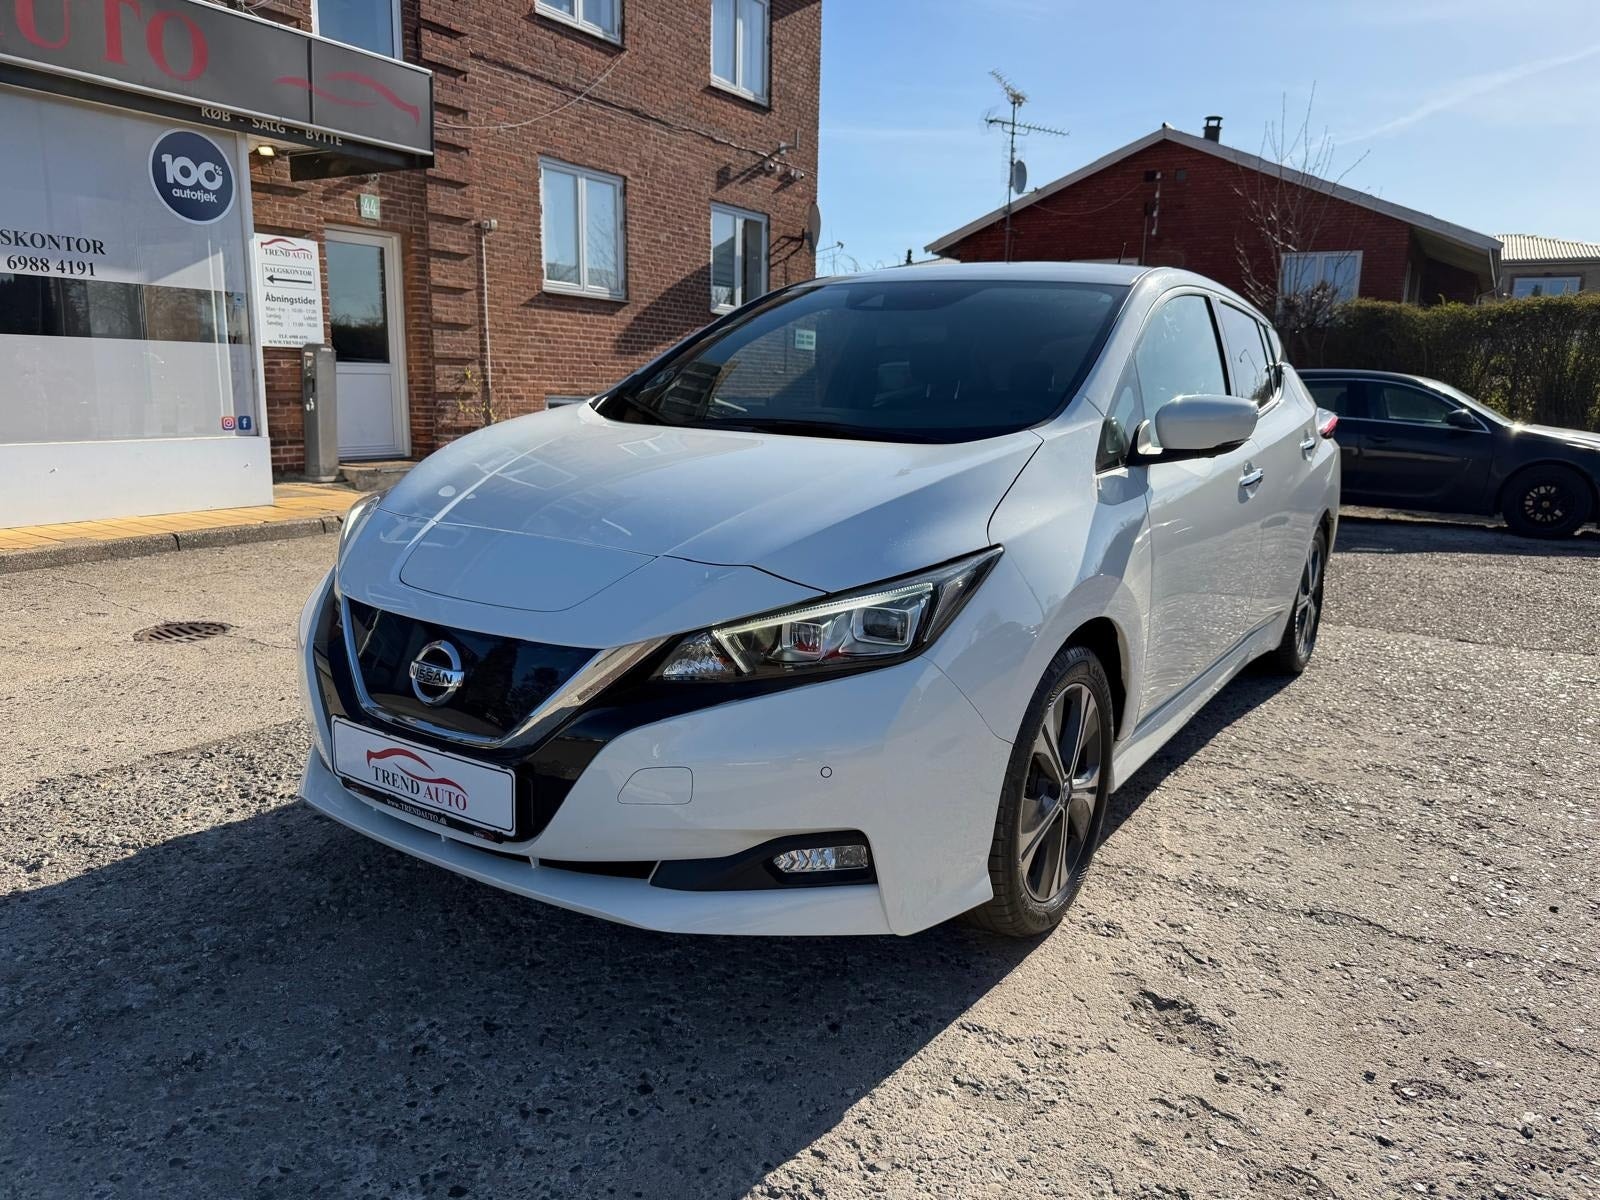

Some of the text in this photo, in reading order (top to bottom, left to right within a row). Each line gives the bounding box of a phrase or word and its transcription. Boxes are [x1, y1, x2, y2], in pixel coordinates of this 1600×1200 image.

[0, 0, 208, 81] UTO
[201, 106, 231, 122] KØB
[252, 118, 286, 134] SALG
[305, 129, 343, 146] BYTTE
[172, 188, 217, 203] autotjek
[364, 198, 377, 215] 44
[0, 229, 106, 255] SKONTOR
[265, 249, 312, 260] TREND AUTO
[7, 255, 96, 276] 6988 4191
[265, 266, 312, 276] SALGSKONTOR
[265, 292, 316, 306] Åbningstider
[410, 663, 453, 685] NISSAN
[372, 766, 467, 811] TREND AUTO
